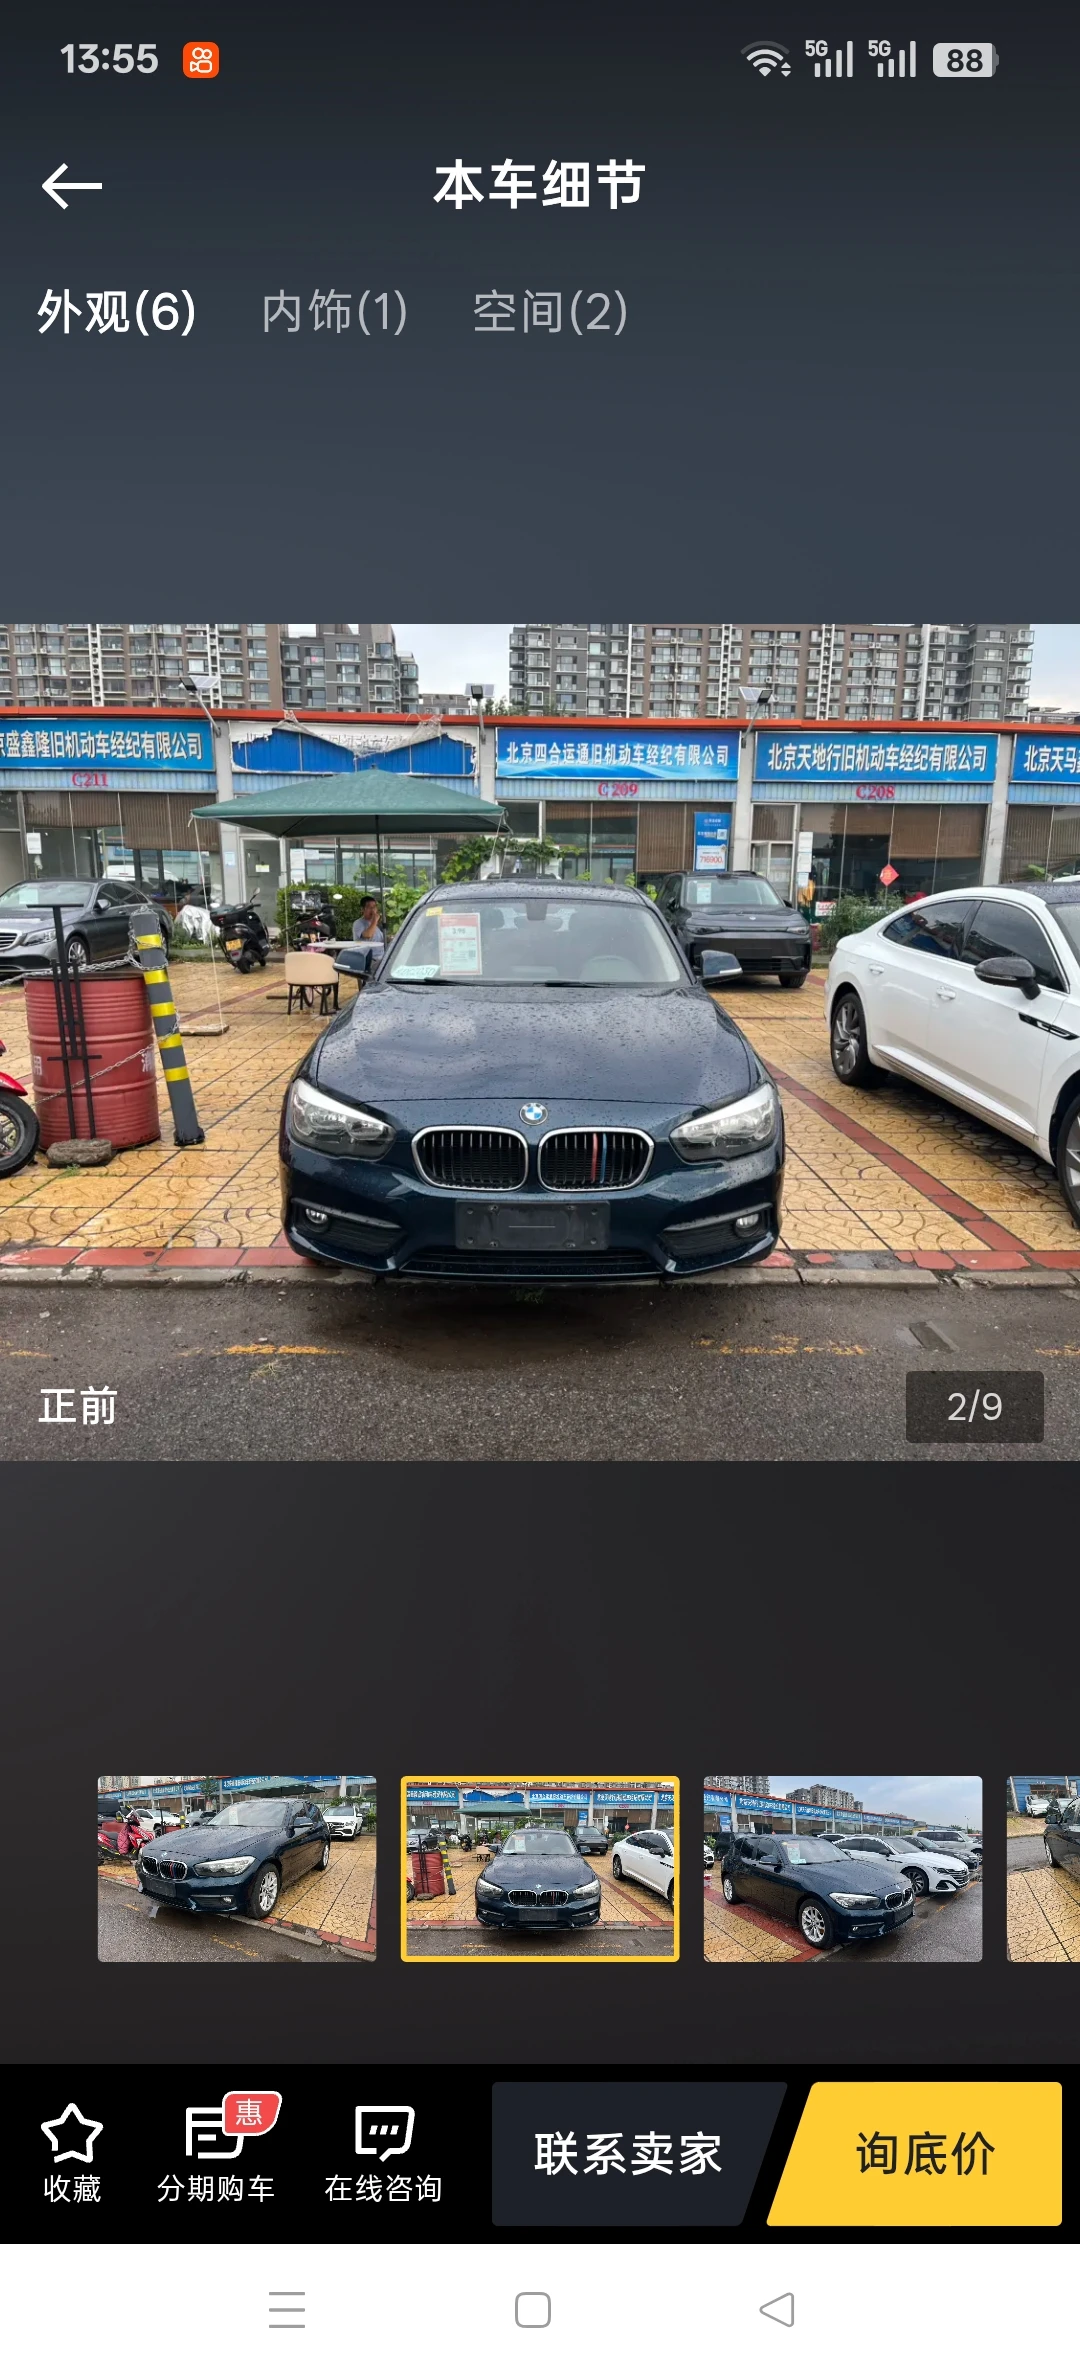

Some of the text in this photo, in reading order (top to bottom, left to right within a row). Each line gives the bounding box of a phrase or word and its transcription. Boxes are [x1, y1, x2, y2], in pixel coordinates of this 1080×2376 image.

[60, 44, 159, 74] 13:55
[804, 39, 829, 57] 5G
[867, 39, 892, 57] 5G
[946, 48, 984, 73] 88
[432, 158, 646, 210] 本车细节
[36, 288, 196, 337] 外观(6)
[262, 288, 408, 337] 内饰(1)
[472, 288, 628, 337] 空间(2)
[506, 741, 729, 767] 北京四合运通旧机动车经纪有限公司
[768, 742, 988, 772] 北京天地行旧机动车经纪有限公司
[71, 772, 109, 788] C211
[855, 784, 896, 800] C208
[235, 2098, 263, 2126] 惠
[533, 2130, 723, 2177] 联系卖家
[856, 2130, 996, 2177] 询底价
[43, 2173, 102, 2204] 收藏
[156, 2173, 275, 2204] 分期购车
[324, 2173, 442, 2204] 在线咨询
